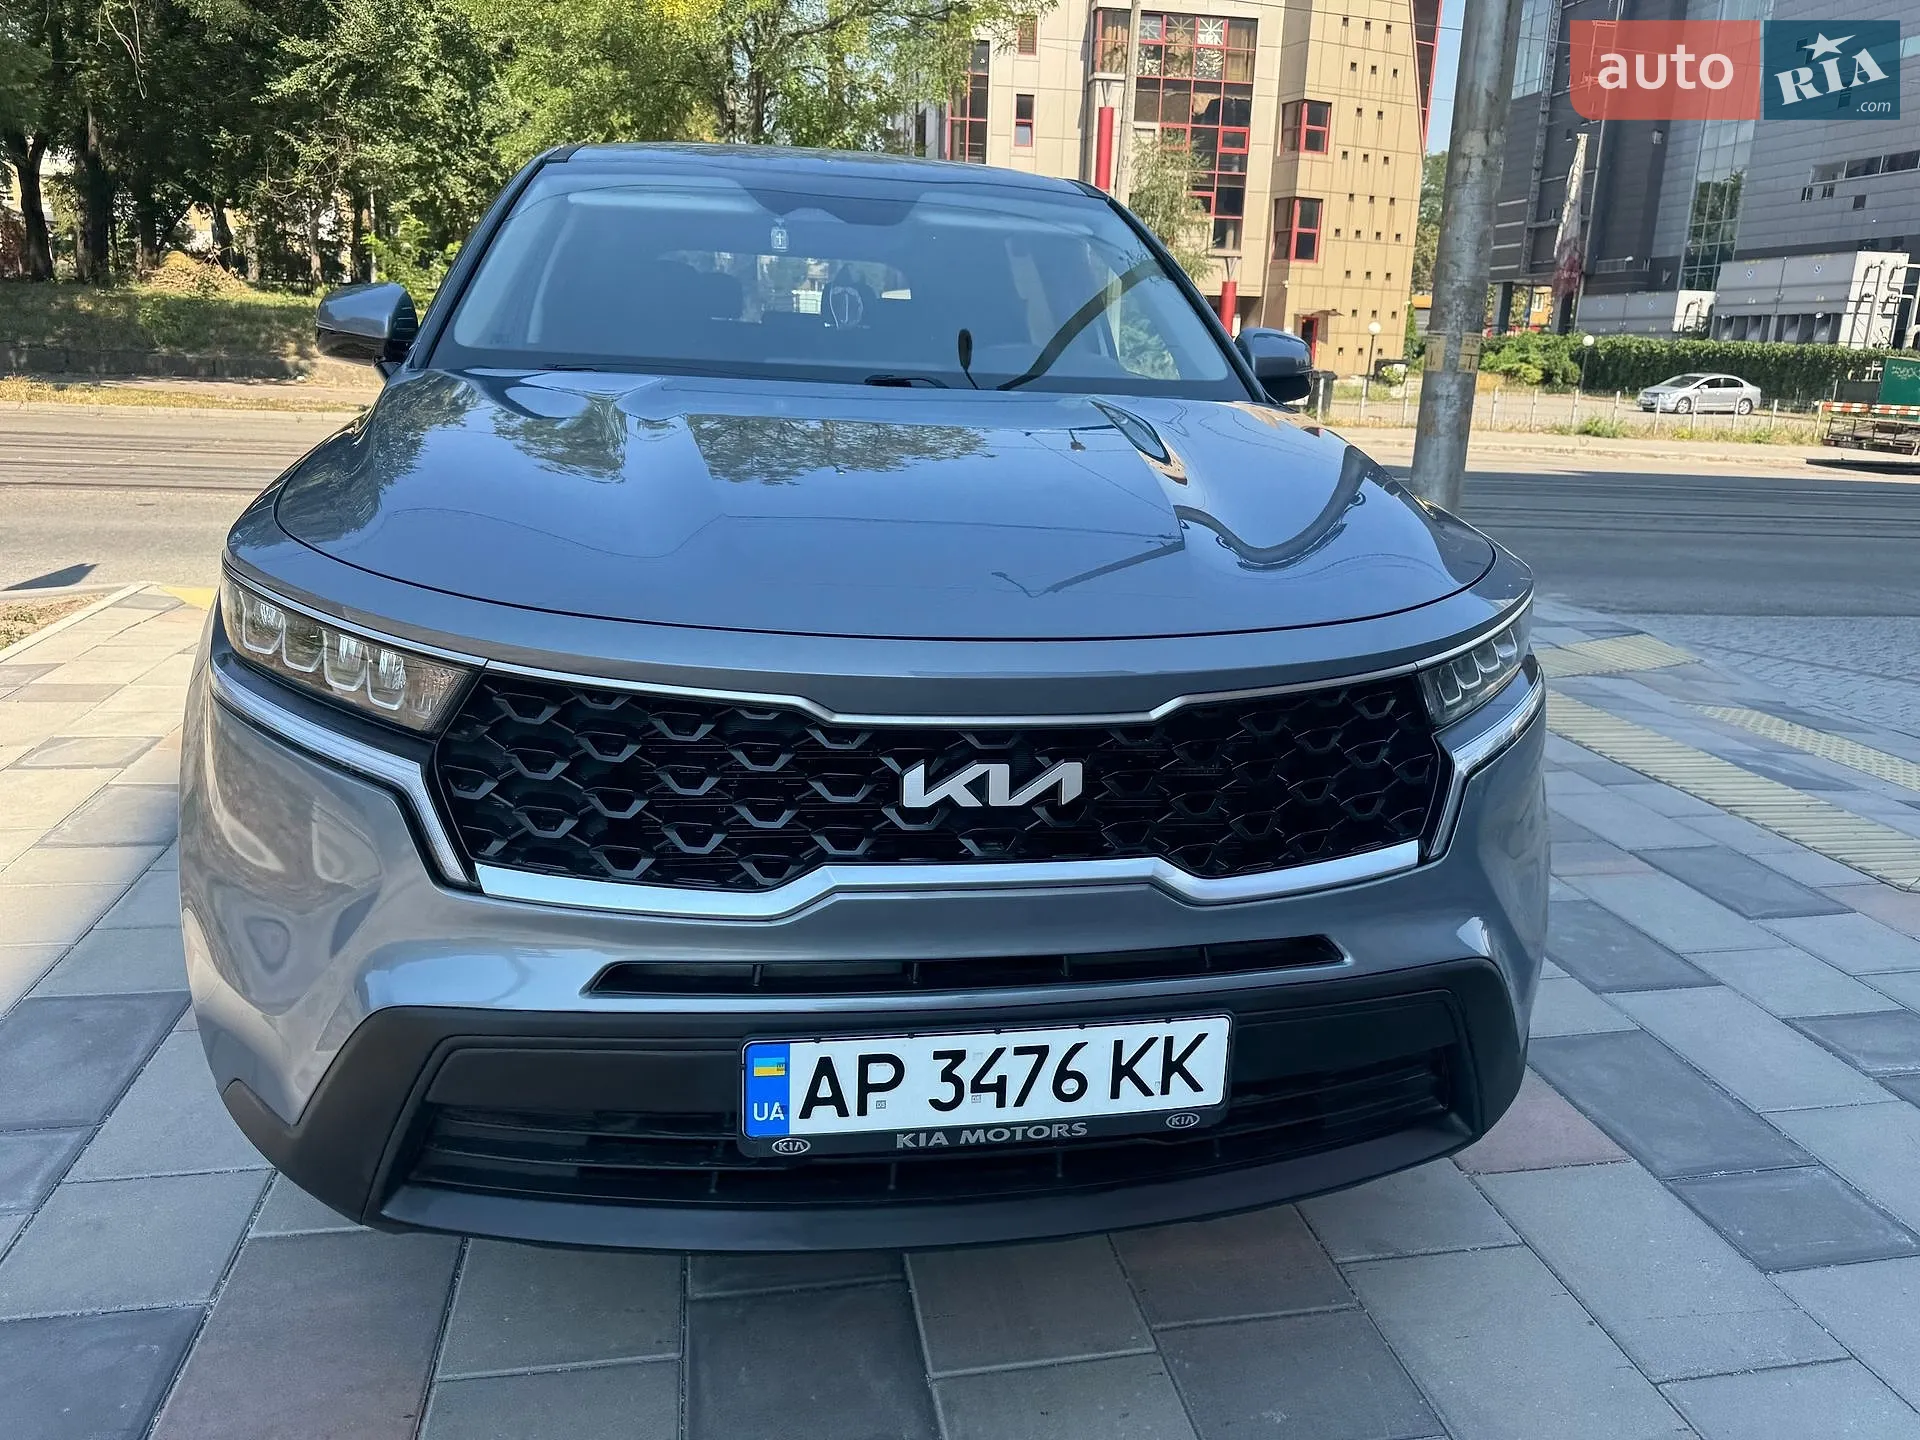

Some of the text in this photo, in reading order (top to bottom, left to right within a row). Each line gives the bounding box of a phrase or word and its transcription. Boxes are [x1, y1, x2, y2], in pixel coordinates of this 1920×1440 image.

[902, 759, 1083, 808] KIA
[798, 1032, 1209, 1120] AP 3476 KK
[753, 1101, 785, 1121] UA
[1171, 1115, 1195, 1126] KIA
[777, 1141, 806, 1152] KIA
[896, 1122, 1088, 1149] KIA MOTORS
